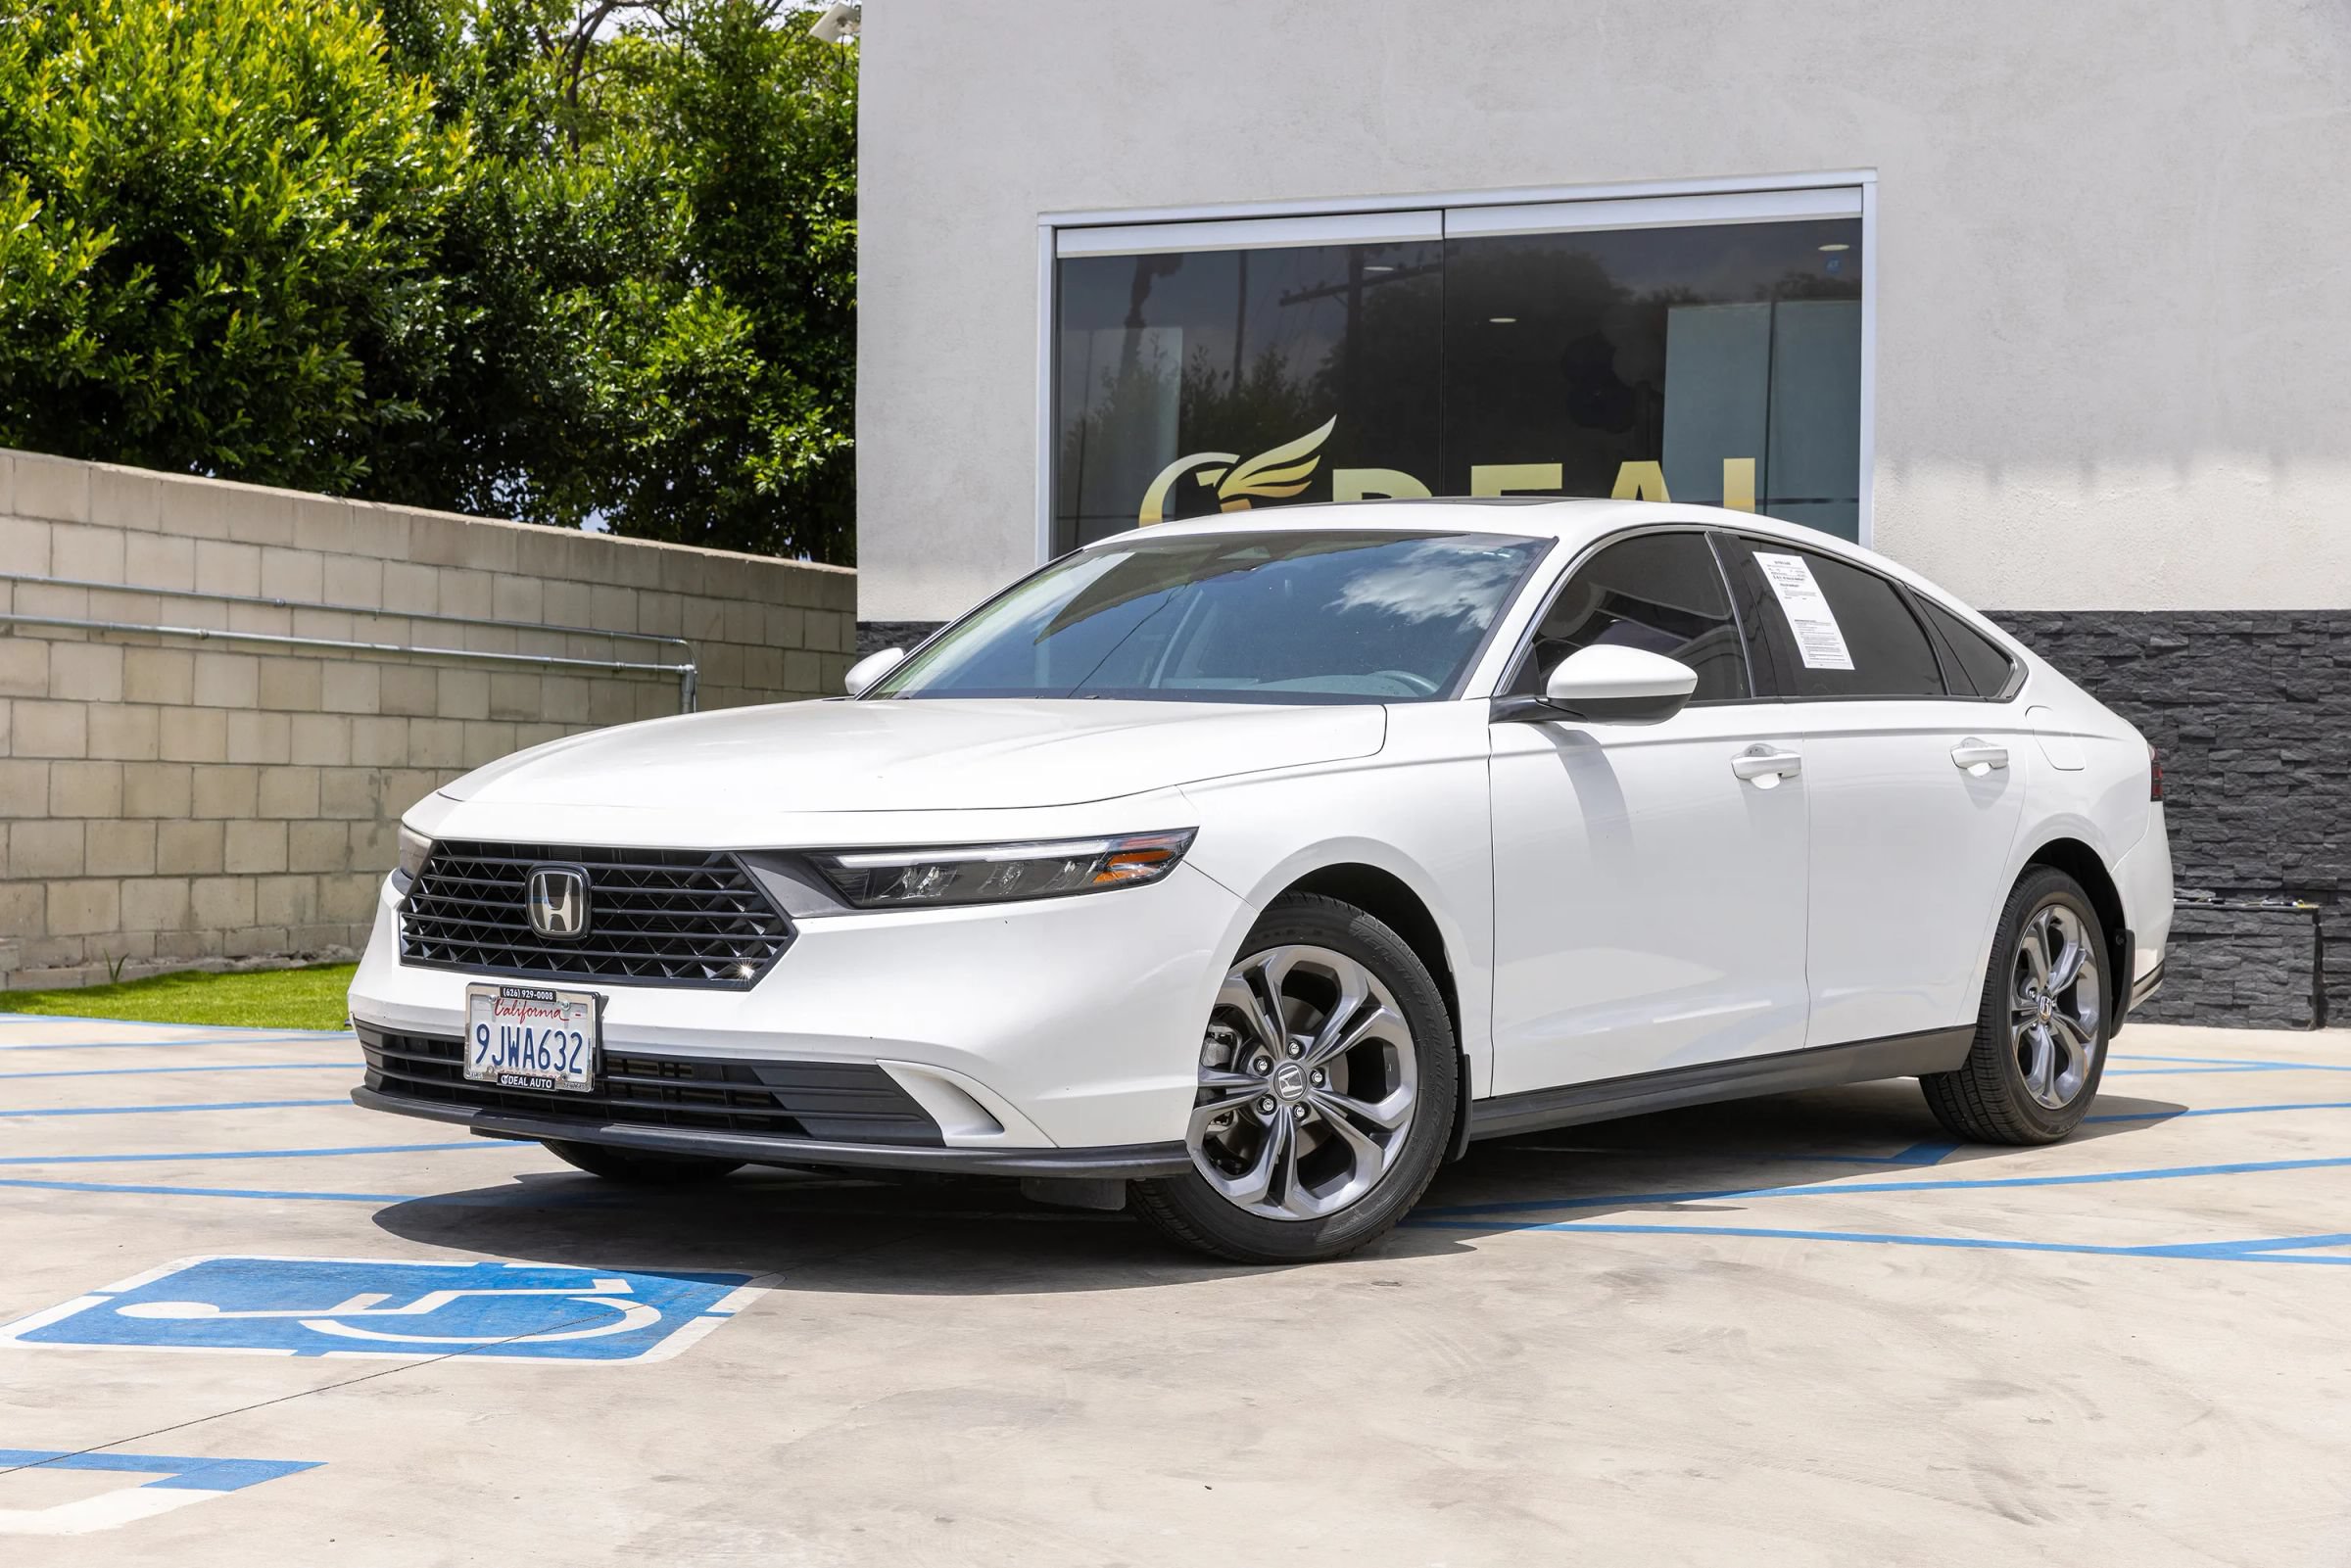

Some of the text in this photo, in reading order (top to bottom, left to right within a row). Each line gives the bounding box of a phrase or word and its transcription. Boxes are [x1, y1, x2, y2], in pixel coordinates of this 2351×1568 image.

[503, 987, 553, 1001] (626) 929-0008
[494, 996, 570, 1024] California
[475, 1023, 583, 1074] 9JWA632
[529, 1077, 552, 1089] AUTO
